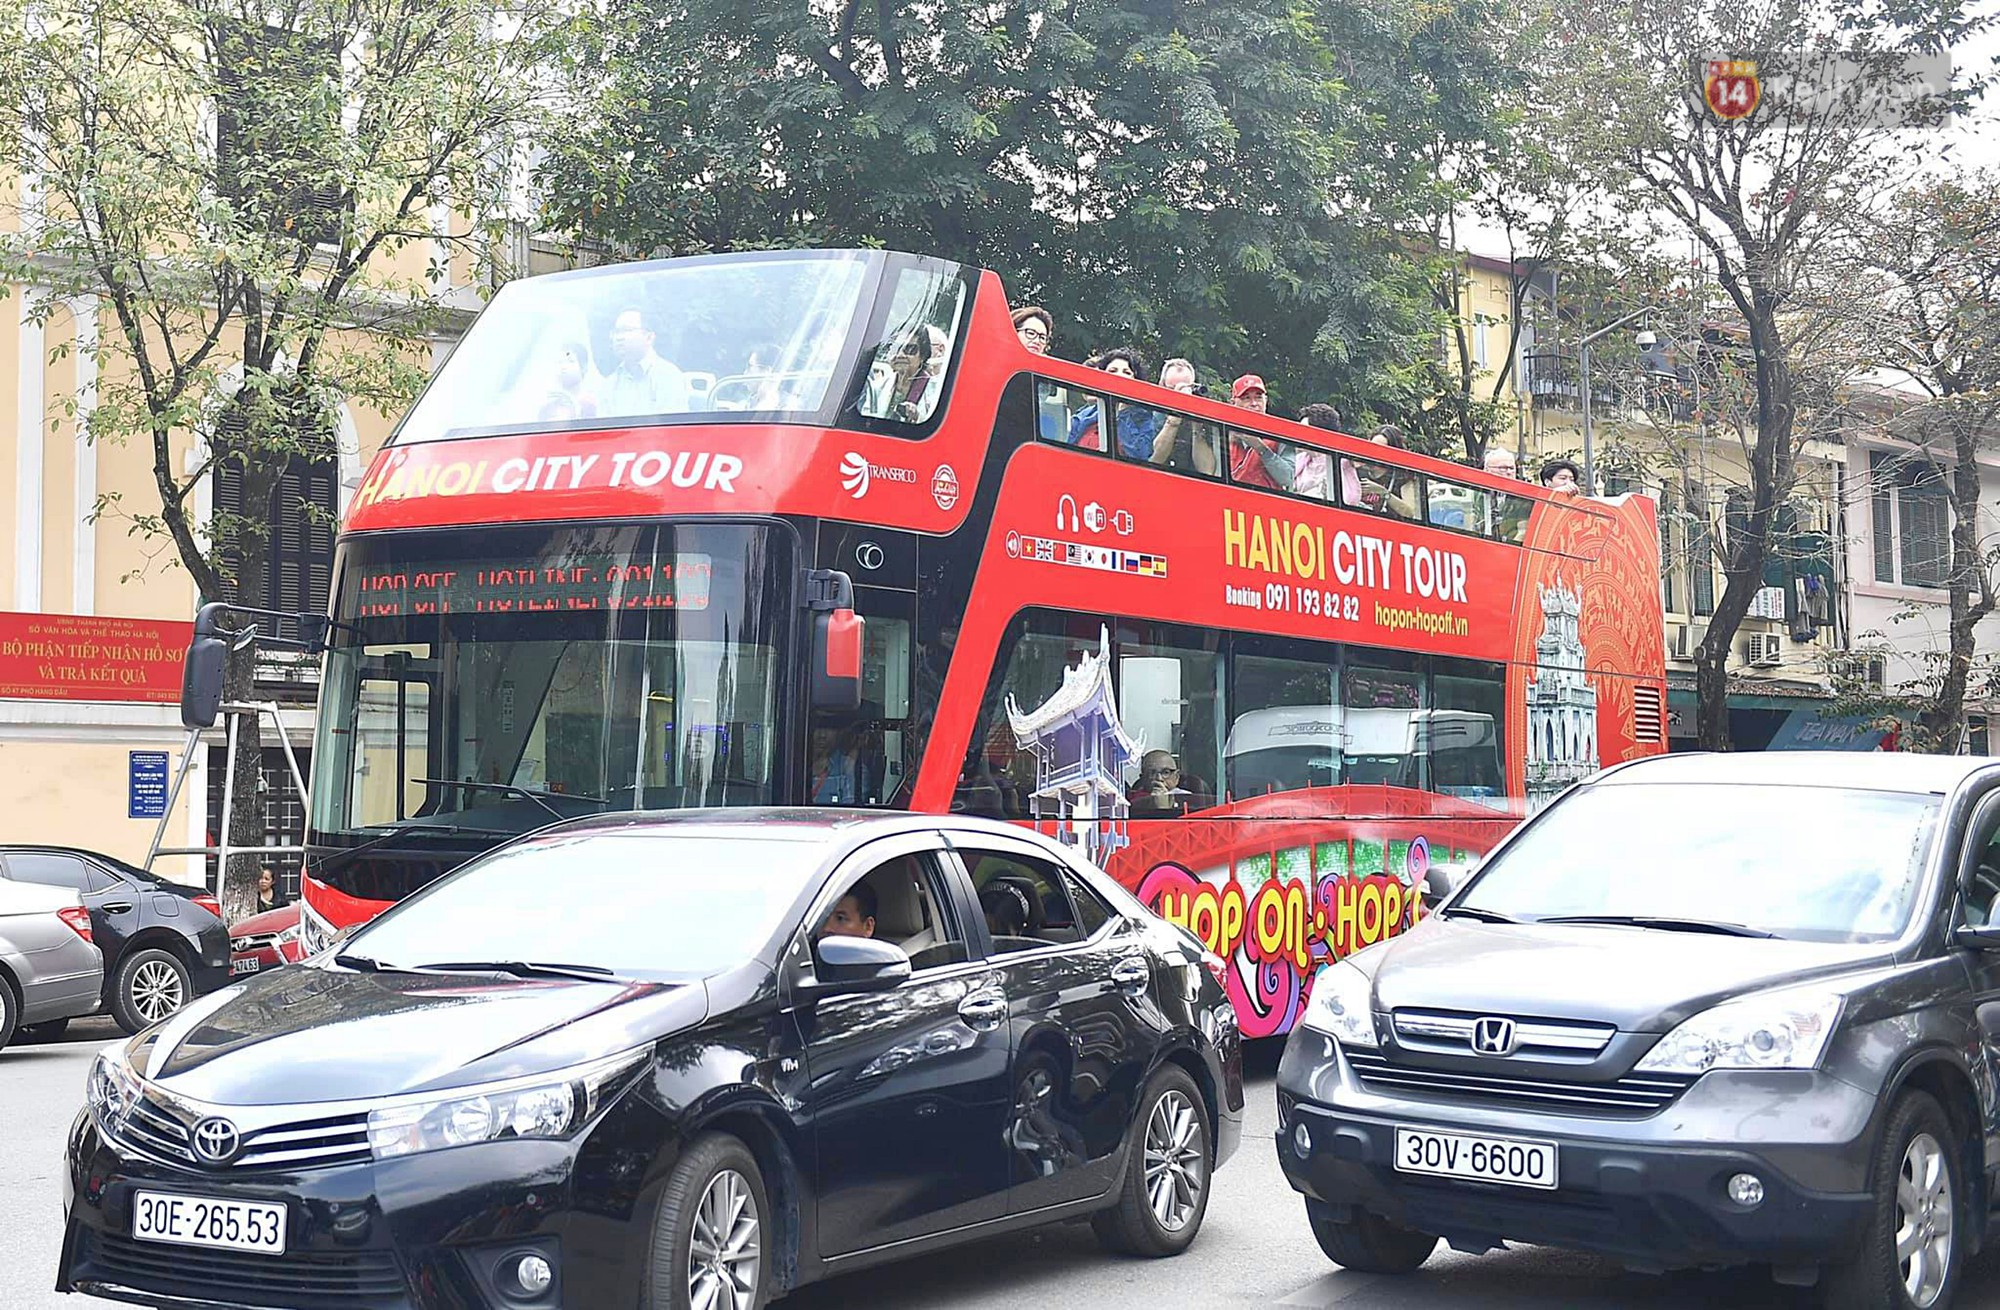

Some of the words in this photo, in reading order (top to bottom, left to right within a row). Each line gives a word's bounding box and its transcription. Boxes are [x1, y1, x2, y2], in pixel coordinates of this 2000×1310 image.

[355, 460, 488, 509] HANOI
[492, 454, 600, 493] CITY
[608, 450, 743, 493] TOUR
[868, 464, 917, 483] TRANSERCO
[1223, 508, 1325, 580] HANOI
[1332, 530, 1393, 590] CITY
[1400, 543, 1468, 603] TOUR
[1226, 584, 1261, 610] Booking
[1265, 582, 1290, 612] 091
[1295, 587, 1320, 616] 193
[1323, 592, 1340, 619] 82
[1343, 595, 1360, 622] 82
[1375, 600, 1469, 637] hopon-hopoff.vn
[3, 637, 22, 659] BỘ
[25, 639, 65, 659] PHẬN
[68, 639, 100, 659] TIẾP
[102, 643, 143, 664] NHẬN
[144, 643, 163, 662] HỒ
[165, 648, 183, 663] SƠ
[38, 663, 55, 680] VÀ
[58, 663, 87, 681] TRẢ
[90, 662, 118, 682] KẾT
[120, 665, 147, 684] QUẢ
[1164, 889, 1243, 958] HOP
[1337, 882, 1401, 955] HOP
[1407, 1135, 1544, 1179] 30V-6600
[139, 1198, 279, 1245] 30E-265.53
